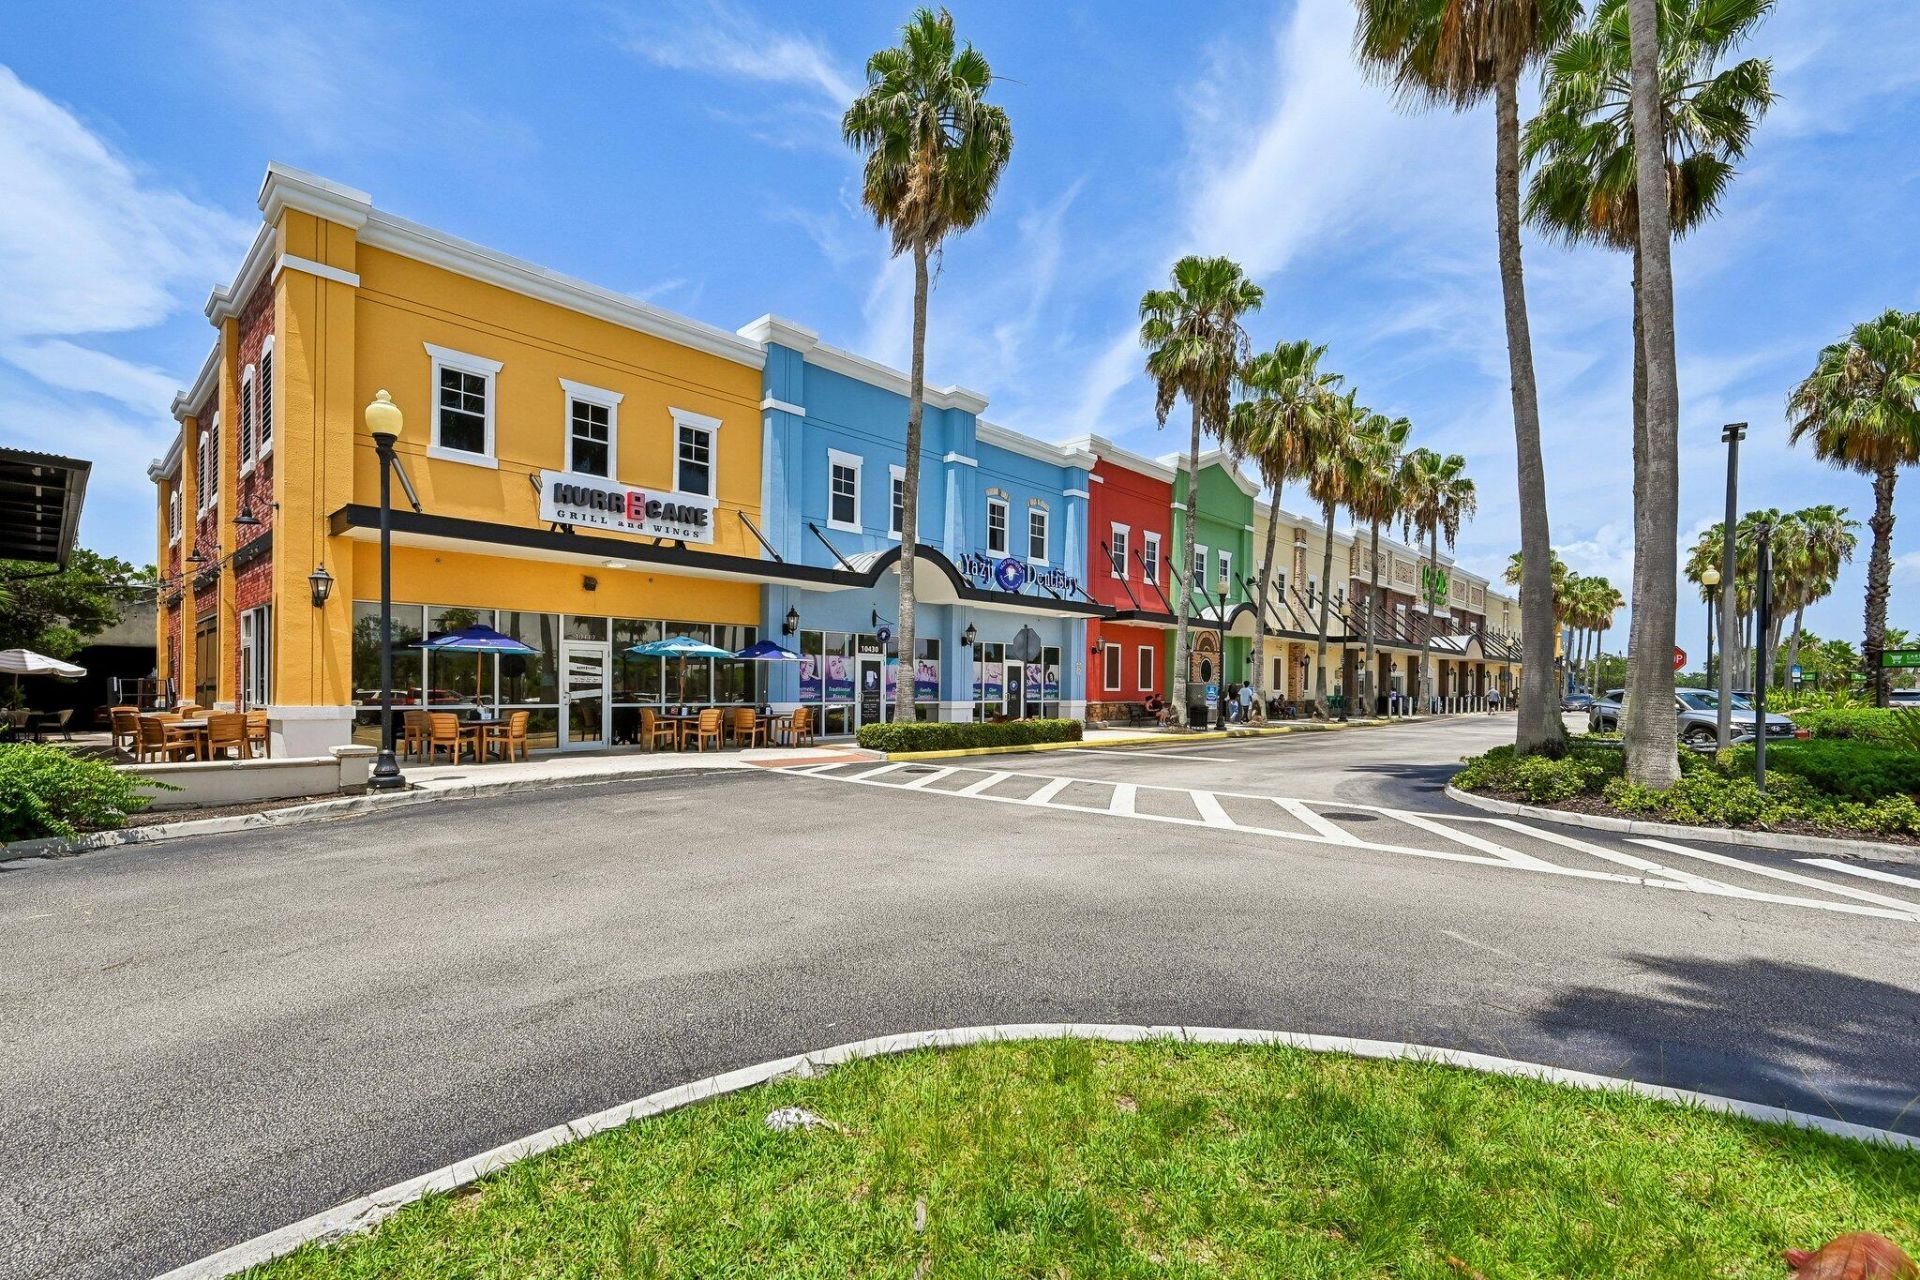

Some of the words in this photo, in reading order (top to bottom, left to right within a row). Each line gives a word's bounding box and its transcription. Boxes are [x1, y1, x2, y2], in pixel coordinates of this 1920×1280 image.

[556, 509, 608, 525] GRILL
[617, 520, 644, 530] and
[653, 524, 700, 538] WINGS
[1027, 564, 1078, 595] Dentistry
